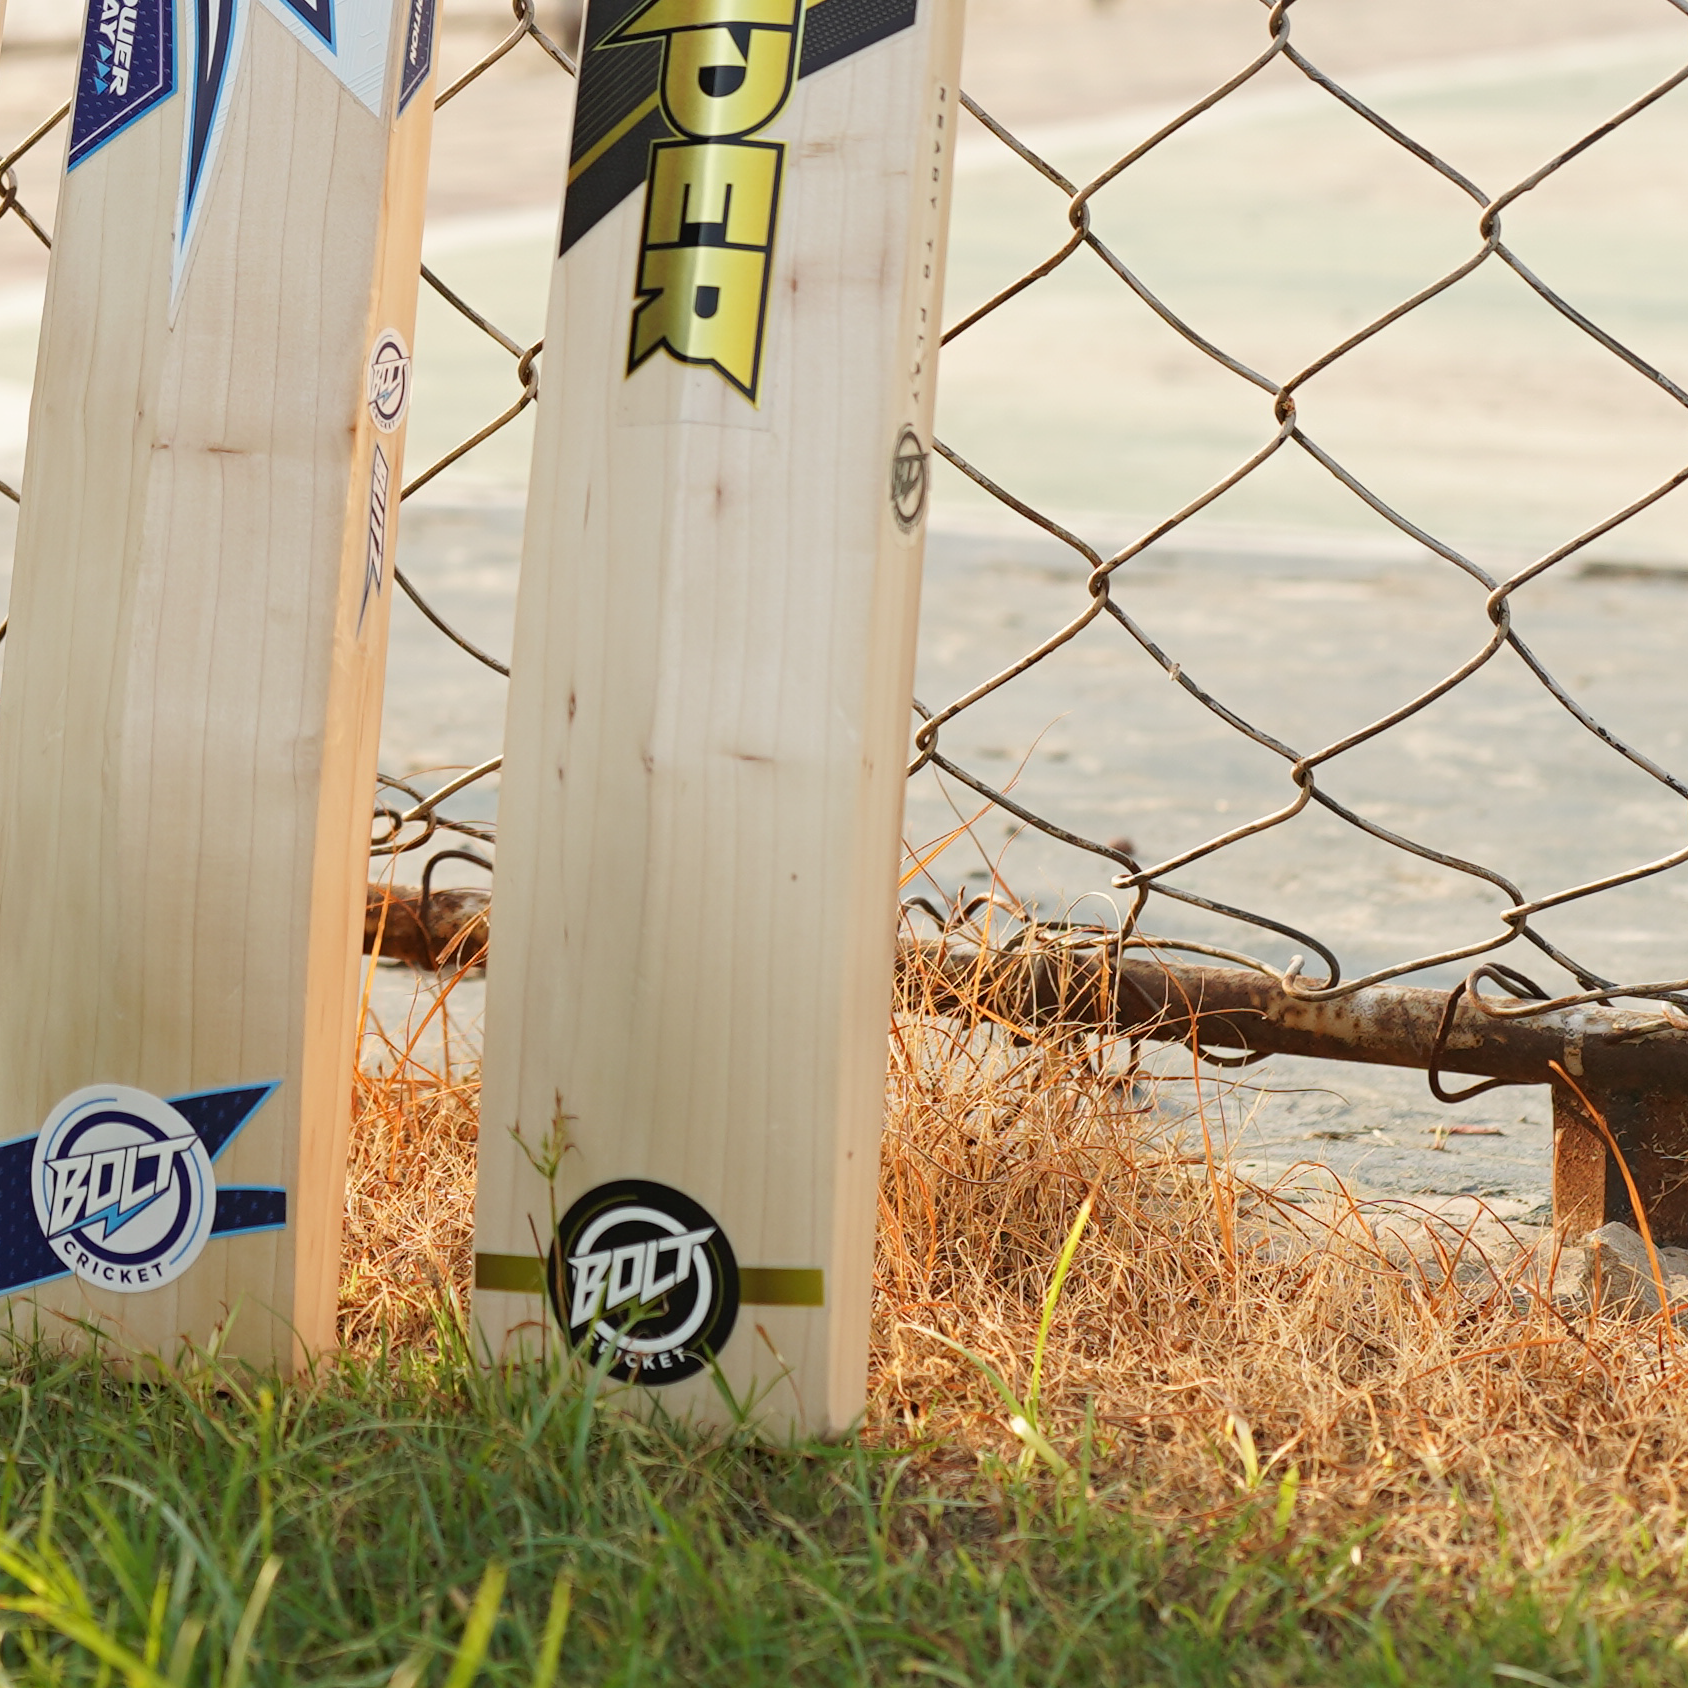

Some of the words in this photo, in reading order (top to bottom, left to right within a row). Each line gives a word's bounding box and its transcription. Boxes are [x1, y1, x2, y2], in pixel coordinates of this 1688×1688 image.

[923, 238, 934, 280] TO
[369, 357, 410, 405] BOLT
[42, 1133, 199, 1240] BOLT
[64, 1241, 163, 1284] CRICKET
[567, 1226, 717, 1329] BOLT
